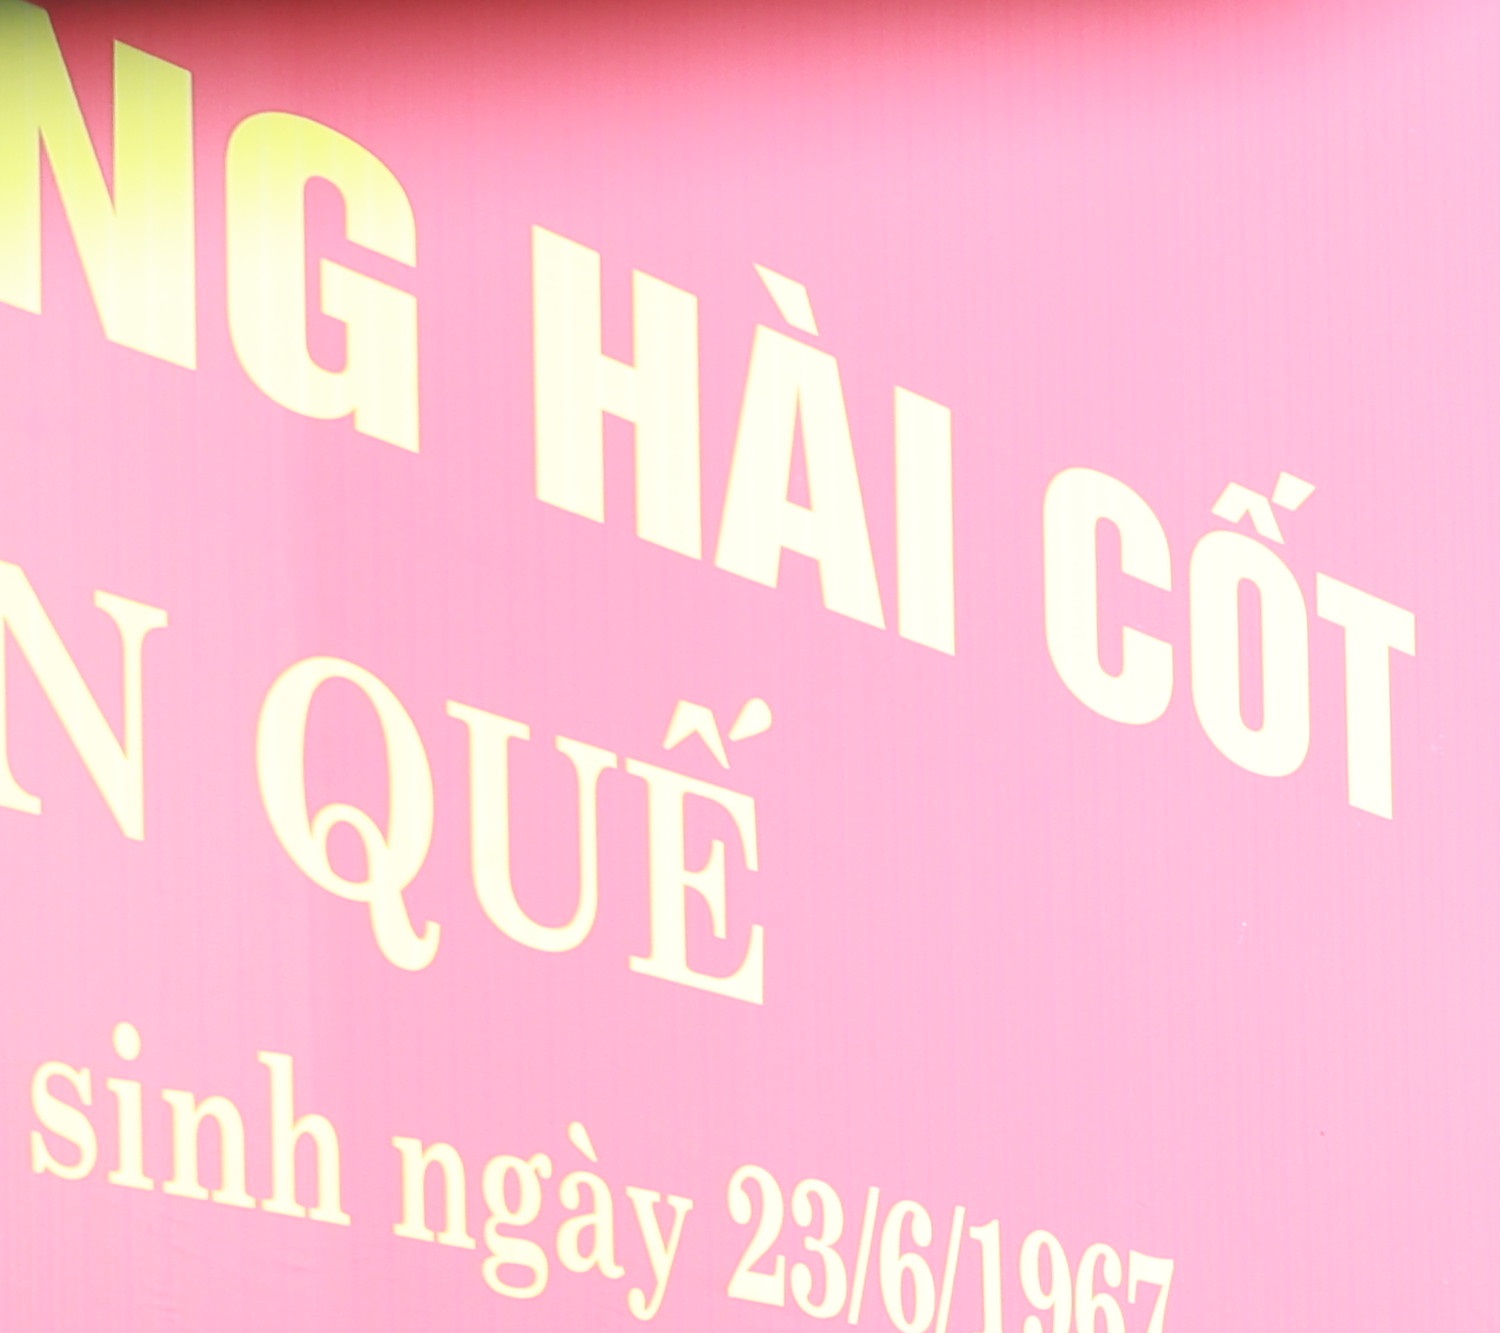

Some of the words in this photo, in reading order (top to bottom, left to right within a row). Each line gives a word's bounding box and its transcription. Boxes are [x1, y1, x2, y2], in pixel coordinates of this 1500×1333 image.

[531, 224, 957, 657] HÀI
[1042, 467, 1417, 821] CỐT
[255, 655, 774, 1005] QUẾ
[30, 1021, 352, 1227] sinh
[392, 1121, 695, 1322] ngày
